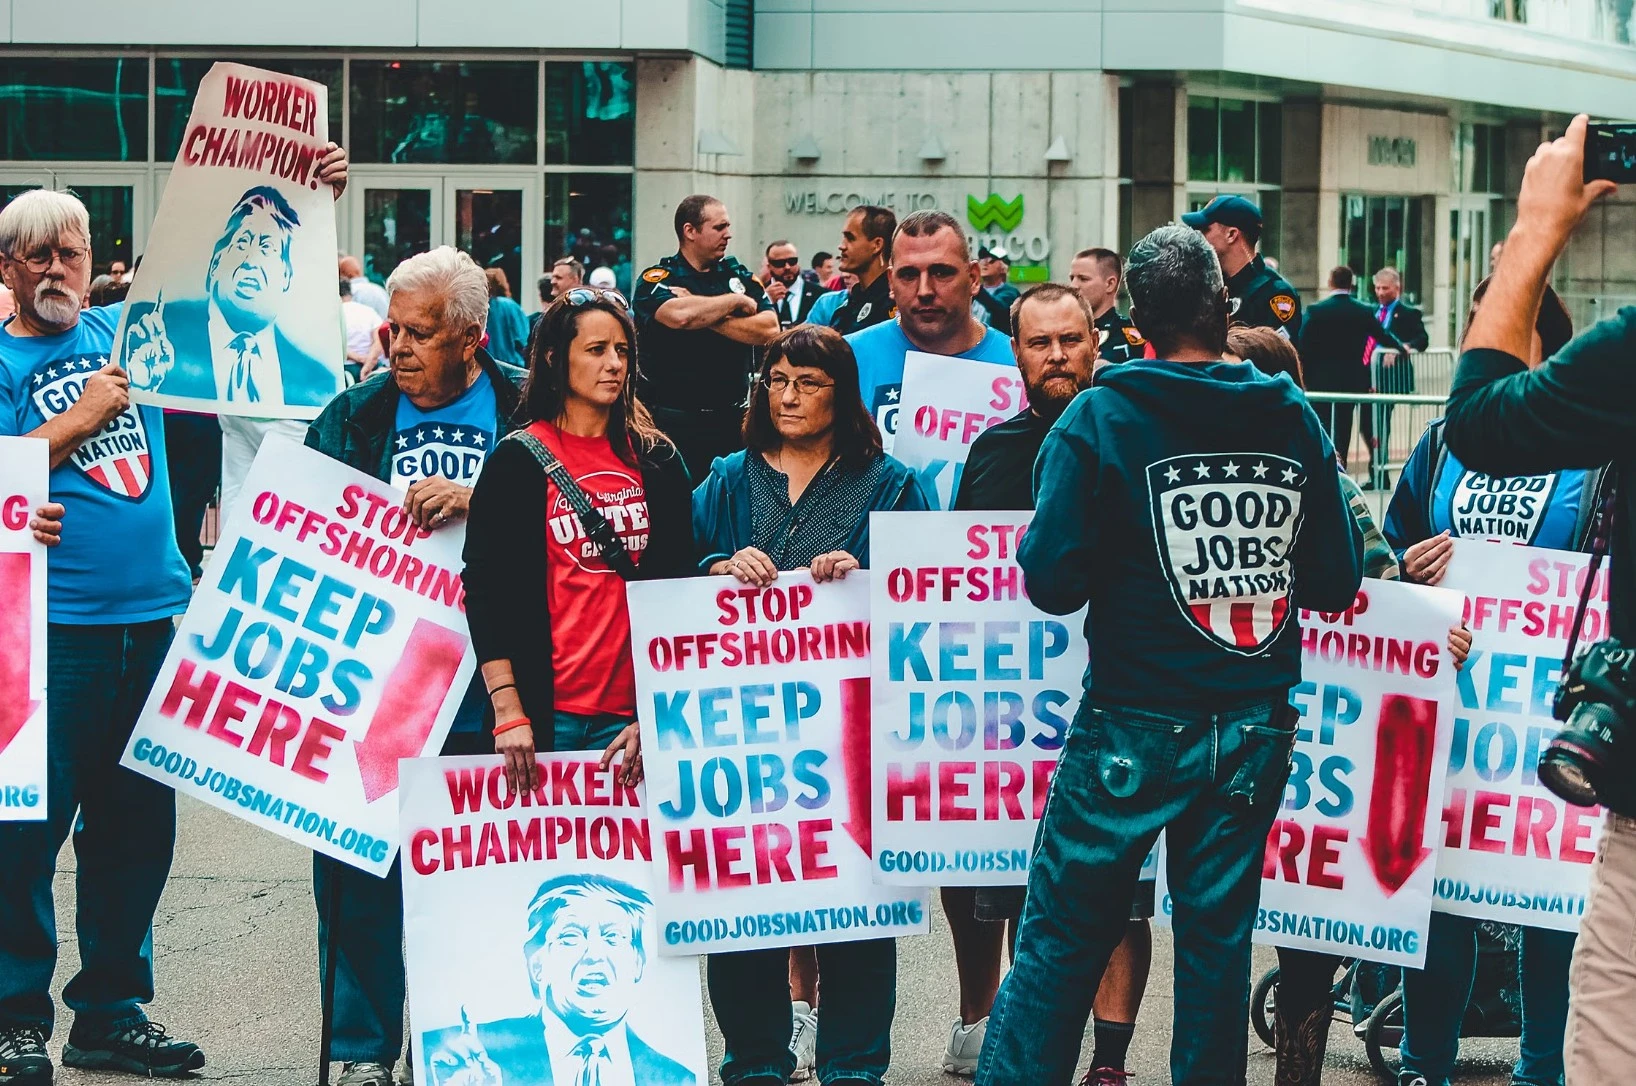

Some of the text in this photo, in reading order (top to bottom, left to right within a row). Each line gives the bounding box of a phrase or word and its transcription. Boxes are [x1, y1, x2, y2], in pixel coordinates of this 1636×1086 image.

[223, 77, 316, 137] WORKER
[184, 125, 328, 190] CHAMPION?
[78, 432, 145, 467] NATION
[396, 449, 481, 480] GOOD
[1171, 491, 1292, 530] GOOD
[1458, 493, 1537, 520] JOBS
[1465, 471, 1547, 493] GOOD
[1182, 535, 1285, 575] JOBS
[1460, 517, 1529, 540] NATION
[217, 536, 395, 649] KEEP
[716, 585, 812, 626] STOP
[1189, 570, 1287, 600] NATION
[189, 607, 373, 716] JOBS
[889, 621, 1069, 681] KEEP
[159, 659, 346, 783] HERE
[653, 681, 821, 751] KEEP
[885, 689, 1070, 751] JOBS
[133, 738, 388, 862] GOODJOBSNATION.ORG
[445, 761, 641, 815] WORKER
[658, 749, 831, 820] JOBS
[665, 819, 838, 893] HERE
[665, 901, 923, 945] GOODJOBSNATION.ORG
